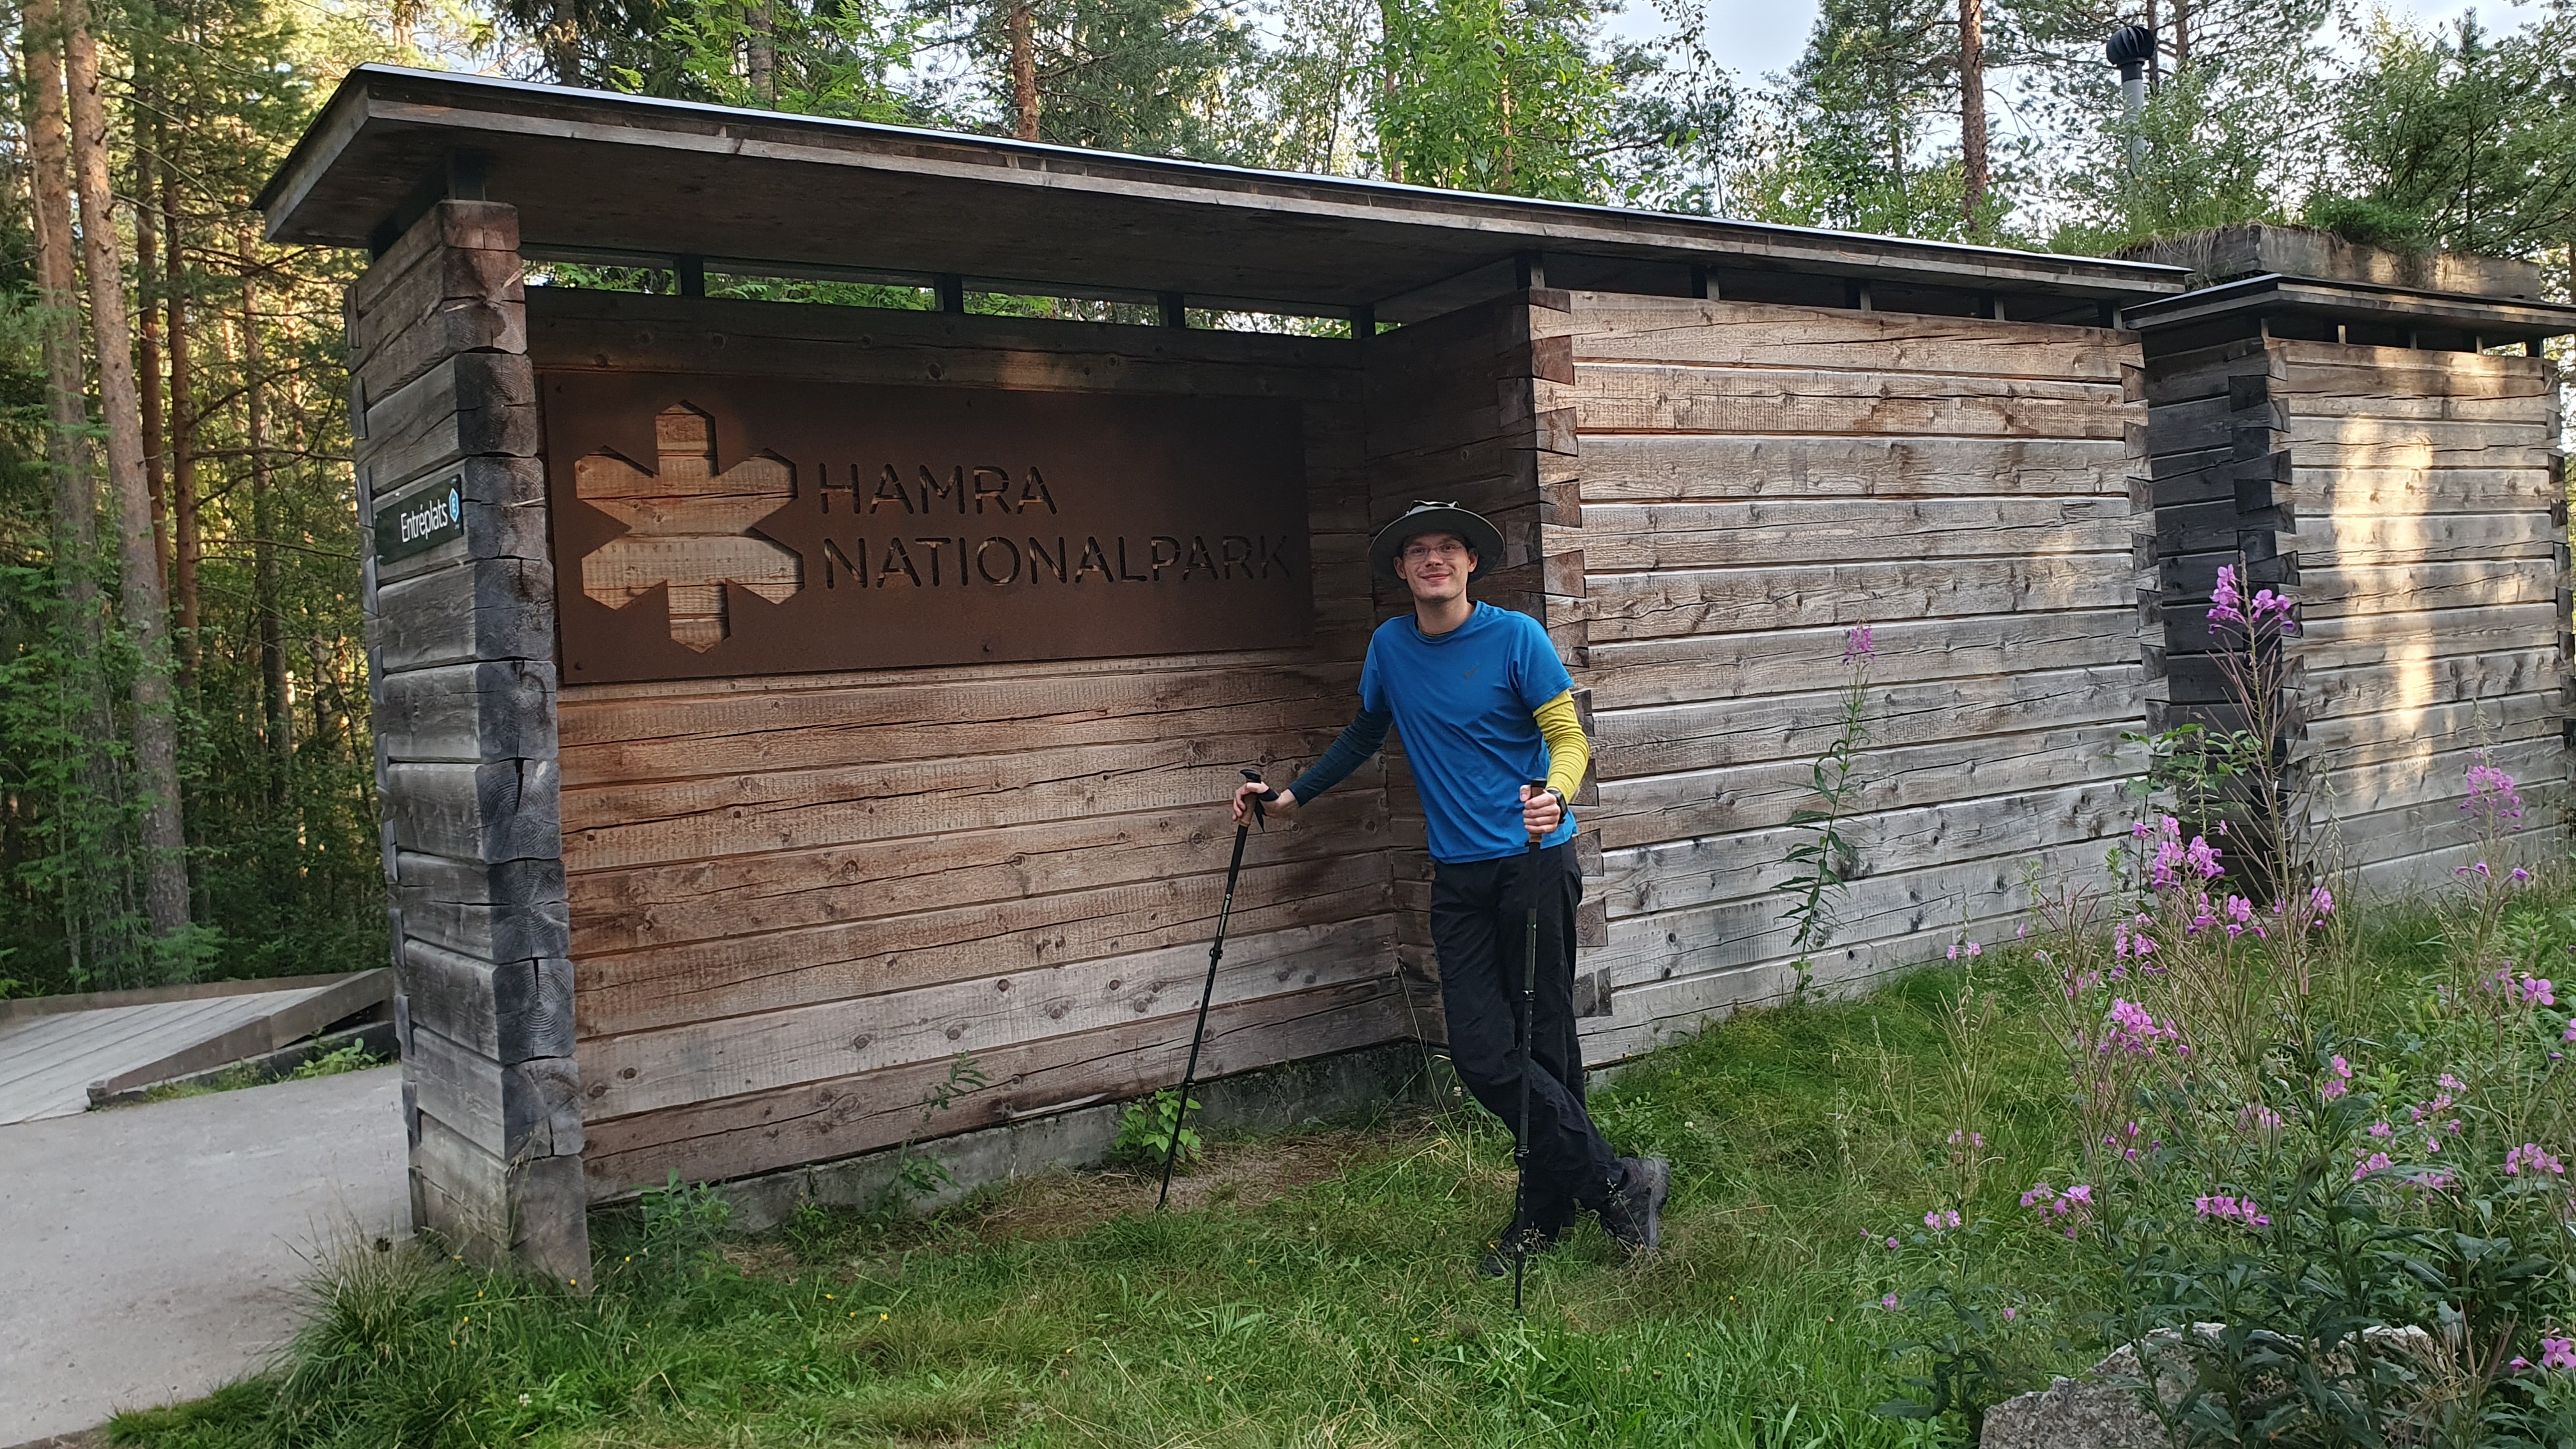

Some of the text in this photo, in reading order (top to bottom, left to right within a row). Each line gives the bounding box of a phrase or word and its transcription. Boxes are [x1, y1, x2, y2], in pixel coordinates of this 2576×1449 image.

[819, 463, 1057, 515] HAMRA
[400, 498, 448, 543] Entréplats
[824, 535, 1291, 589] NATIONALPARK
